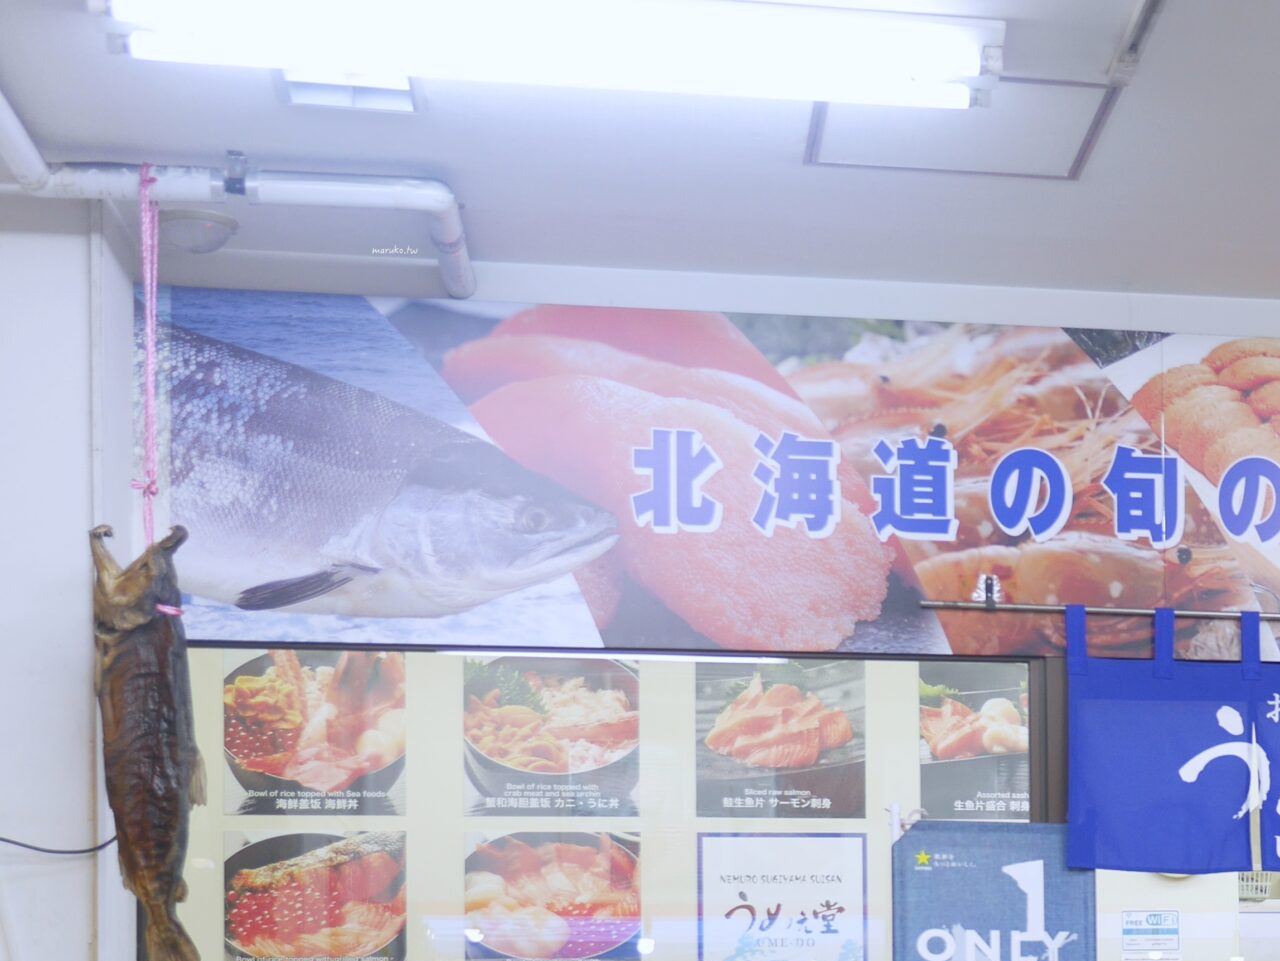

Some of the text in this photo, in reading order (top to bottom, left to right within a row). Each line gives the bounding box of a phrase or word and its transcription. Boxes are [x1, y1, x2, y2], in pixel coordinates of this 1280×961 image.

[248, 789, 269, 798] Bowl
[270, 789, 279, 798] of
[280, 789, 296, 798] rice
[297, 790, 326, 799] topped
[327, 790, 346, 798] with
[744, 788, 767, 796] Sliced
[783, 788, 812, 797] salmon
[976, 791, 1010, 799] Assorted
